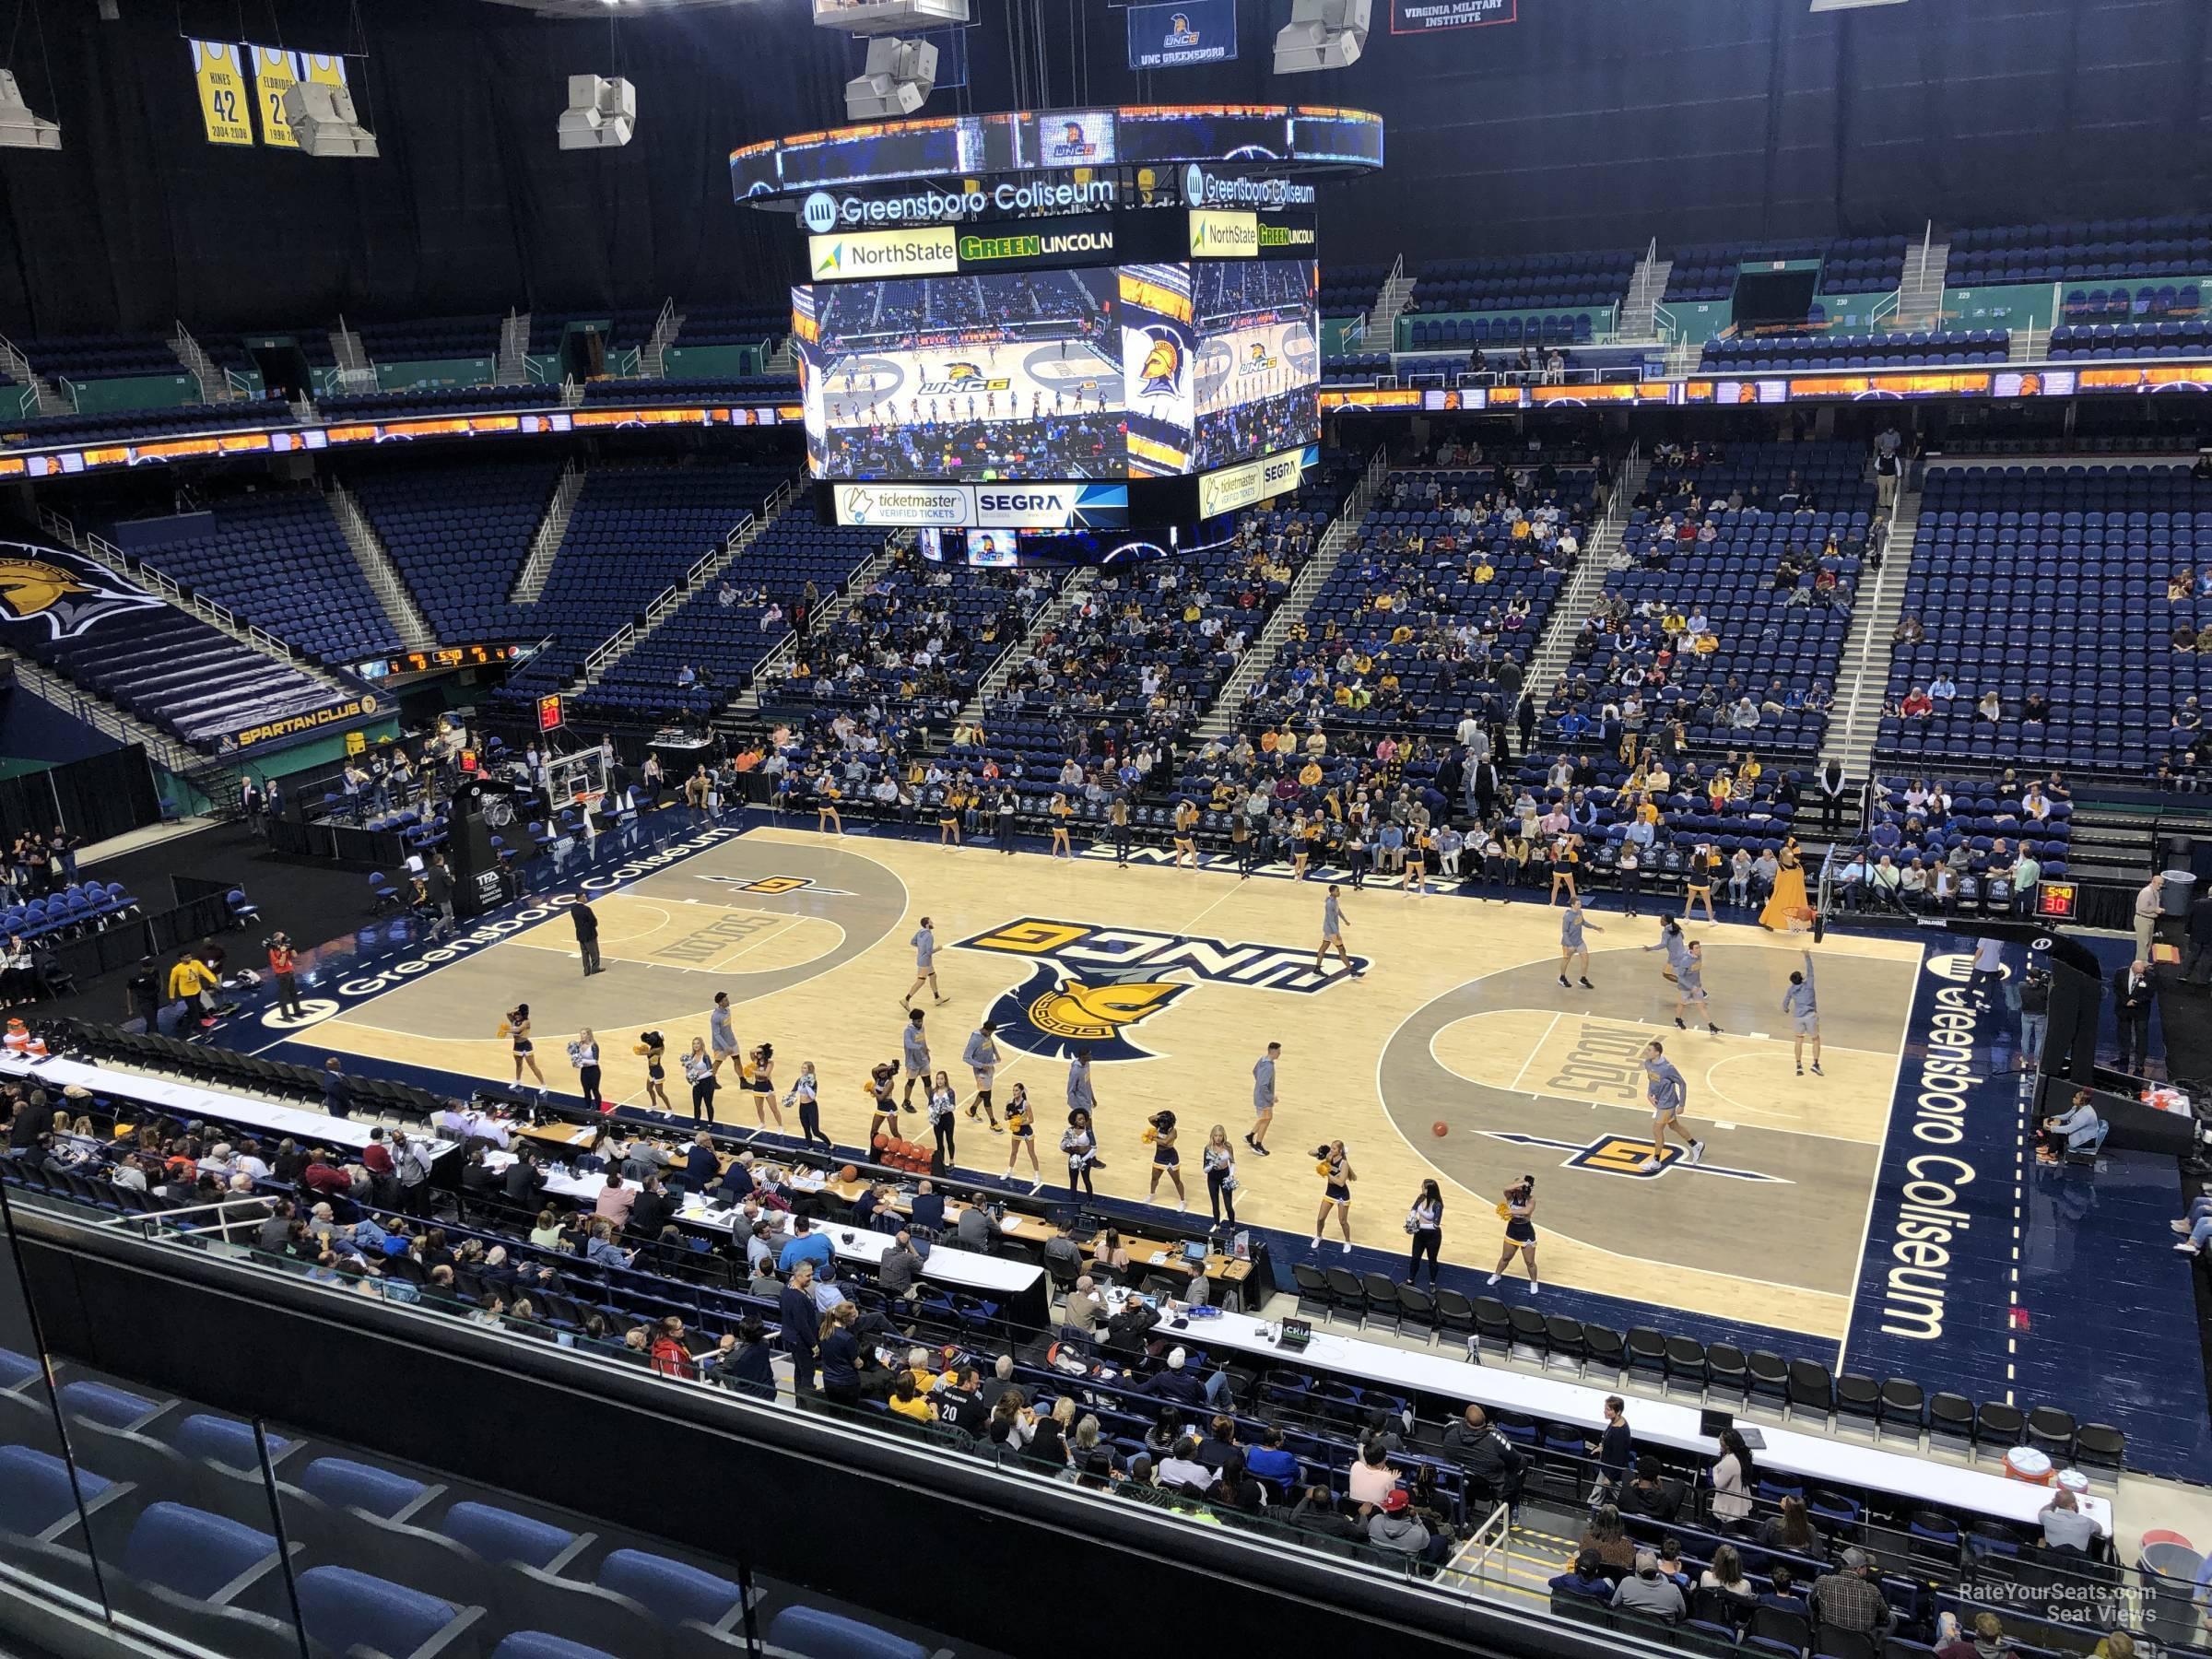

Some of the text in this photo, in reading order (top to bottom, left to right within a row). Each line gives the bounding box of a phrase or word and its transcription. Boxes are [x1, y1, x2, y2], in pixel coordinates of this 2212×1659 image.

[1405, 0, 1502, 18] VIRGINIA MILITARY
[1425, 12, 1481, 28] INSTITUTE
[1164, 33, 1198, 46] UNCG
[1141, 47, 1224, 65] UNC GREENSBORO
[209, 72, 231, 86] HINES
[214, 89, 239, 123] 42
[1206, 173, 1315, 204] Greensboro Coliseum
[841, 191, 985, 223] Greensboro
[994, 181, 1113, 210] Coliseum
[1209, 224, 1255, 244] NorthState
[1258, 223, 1314, 246] GREEN LINCOLN
[852, 242, 953, 265] NorthState
[959, 232, 1112, 260] GREEN LINCOLN
[1239, 357, 1277, 376] UNCG
[919, 378, 1011, 395] UNCG
[1265, 460, 1296, 483] SEGRA
[1220, 473, 1256, 494] ticketmaster
[878, 493, 957, 508] ticketmaster
[980, 495, 1063, 511] SEGRA
[879, 509, 955, 518] VERIFIED TICKETS
[439, 650, 462, 661] 5:40
[542, 697, 559, 709] 5:40
[239, 702, 360, 746] SPARTAN CLUB
[543, 708, 559, 725] 30
[476, 871, 500, 886] TFA
[2047, 887, 2072, 899] 5:40
[338, 828, 740, 996] Greensboro Coliseum
[2045, 899, 2066, 912] 30
[1917, 918, 1947, 927] SPALDING
[968, 919, 1362, 993] UNCG
[1881, 986, 1983, 1340] Greensboro Coliseum
[942, 1405, 958, 1421] 20
